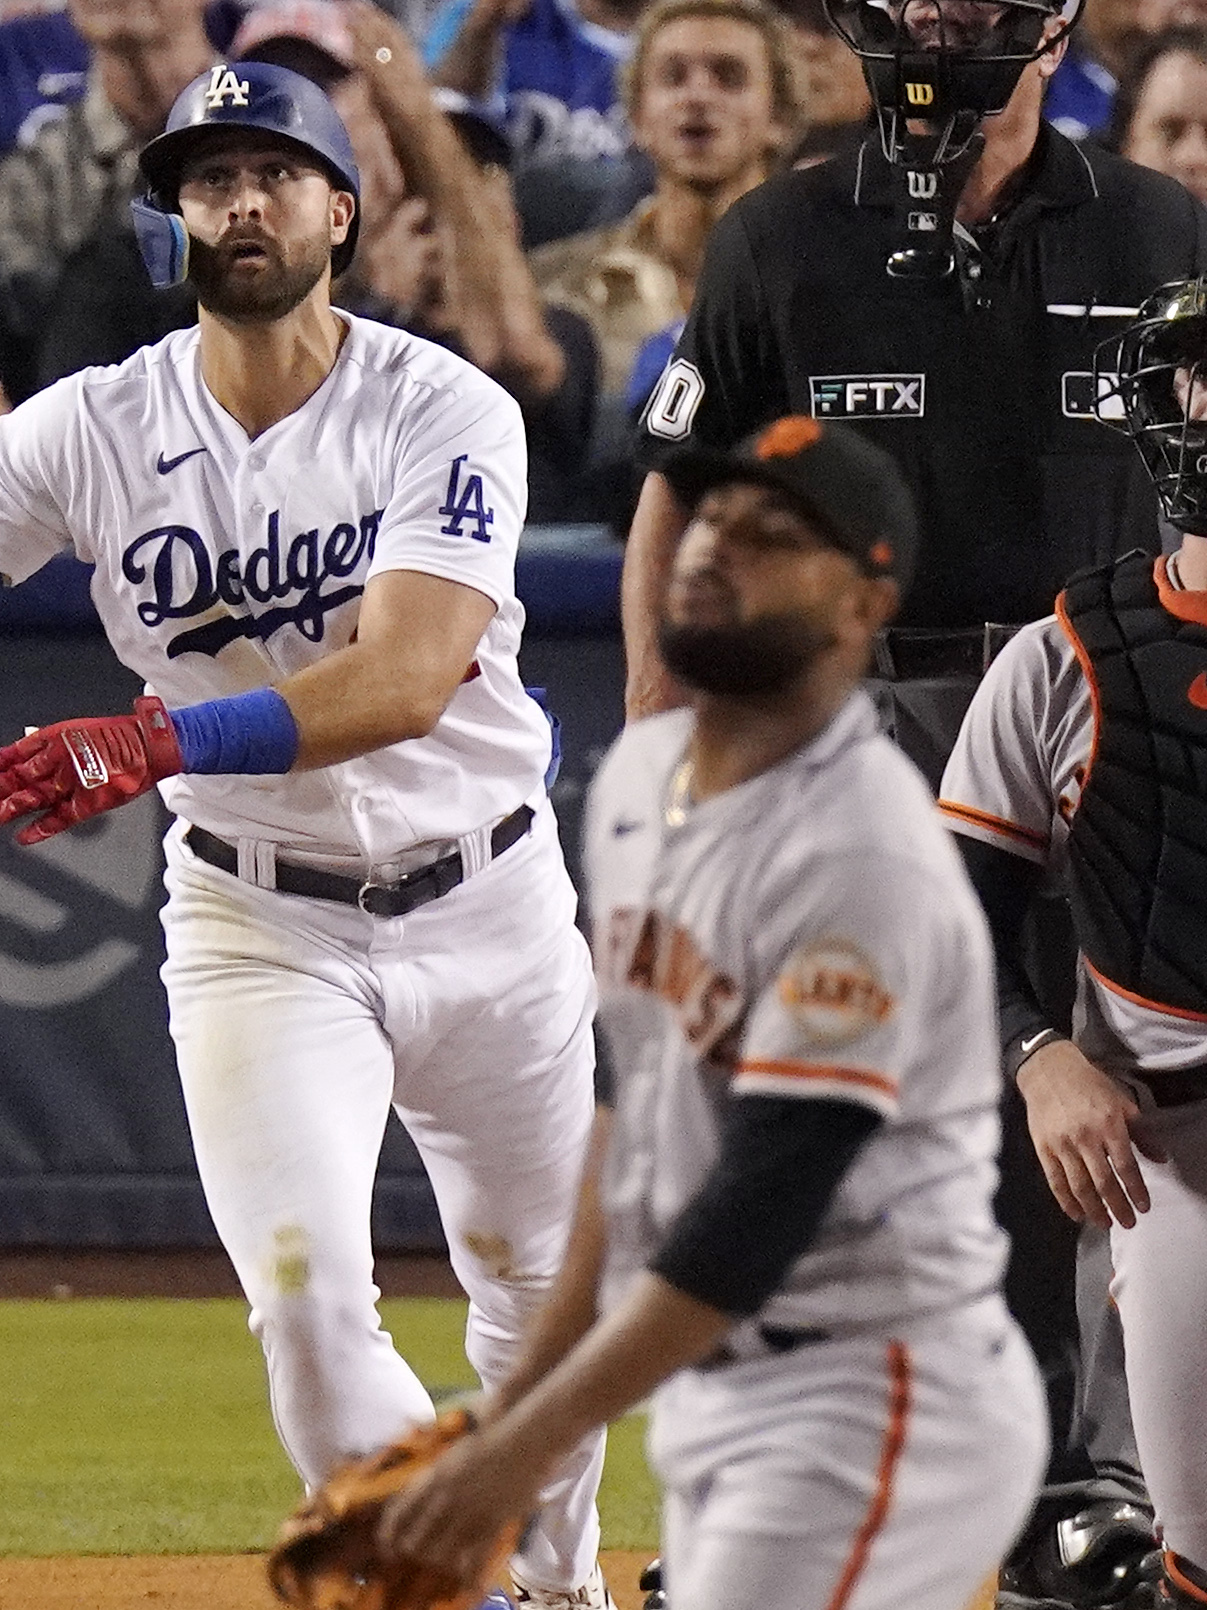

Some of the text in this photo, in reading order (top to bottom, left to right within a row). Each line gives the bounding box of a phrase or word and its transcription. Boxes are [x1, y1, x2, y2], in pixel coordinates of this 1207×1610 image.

[205, 65, 250, 108] LA
[638, 353, 706, 442] 0
[845, 381, 920, 413] FTX
[439, 454, 494, 544] LA
